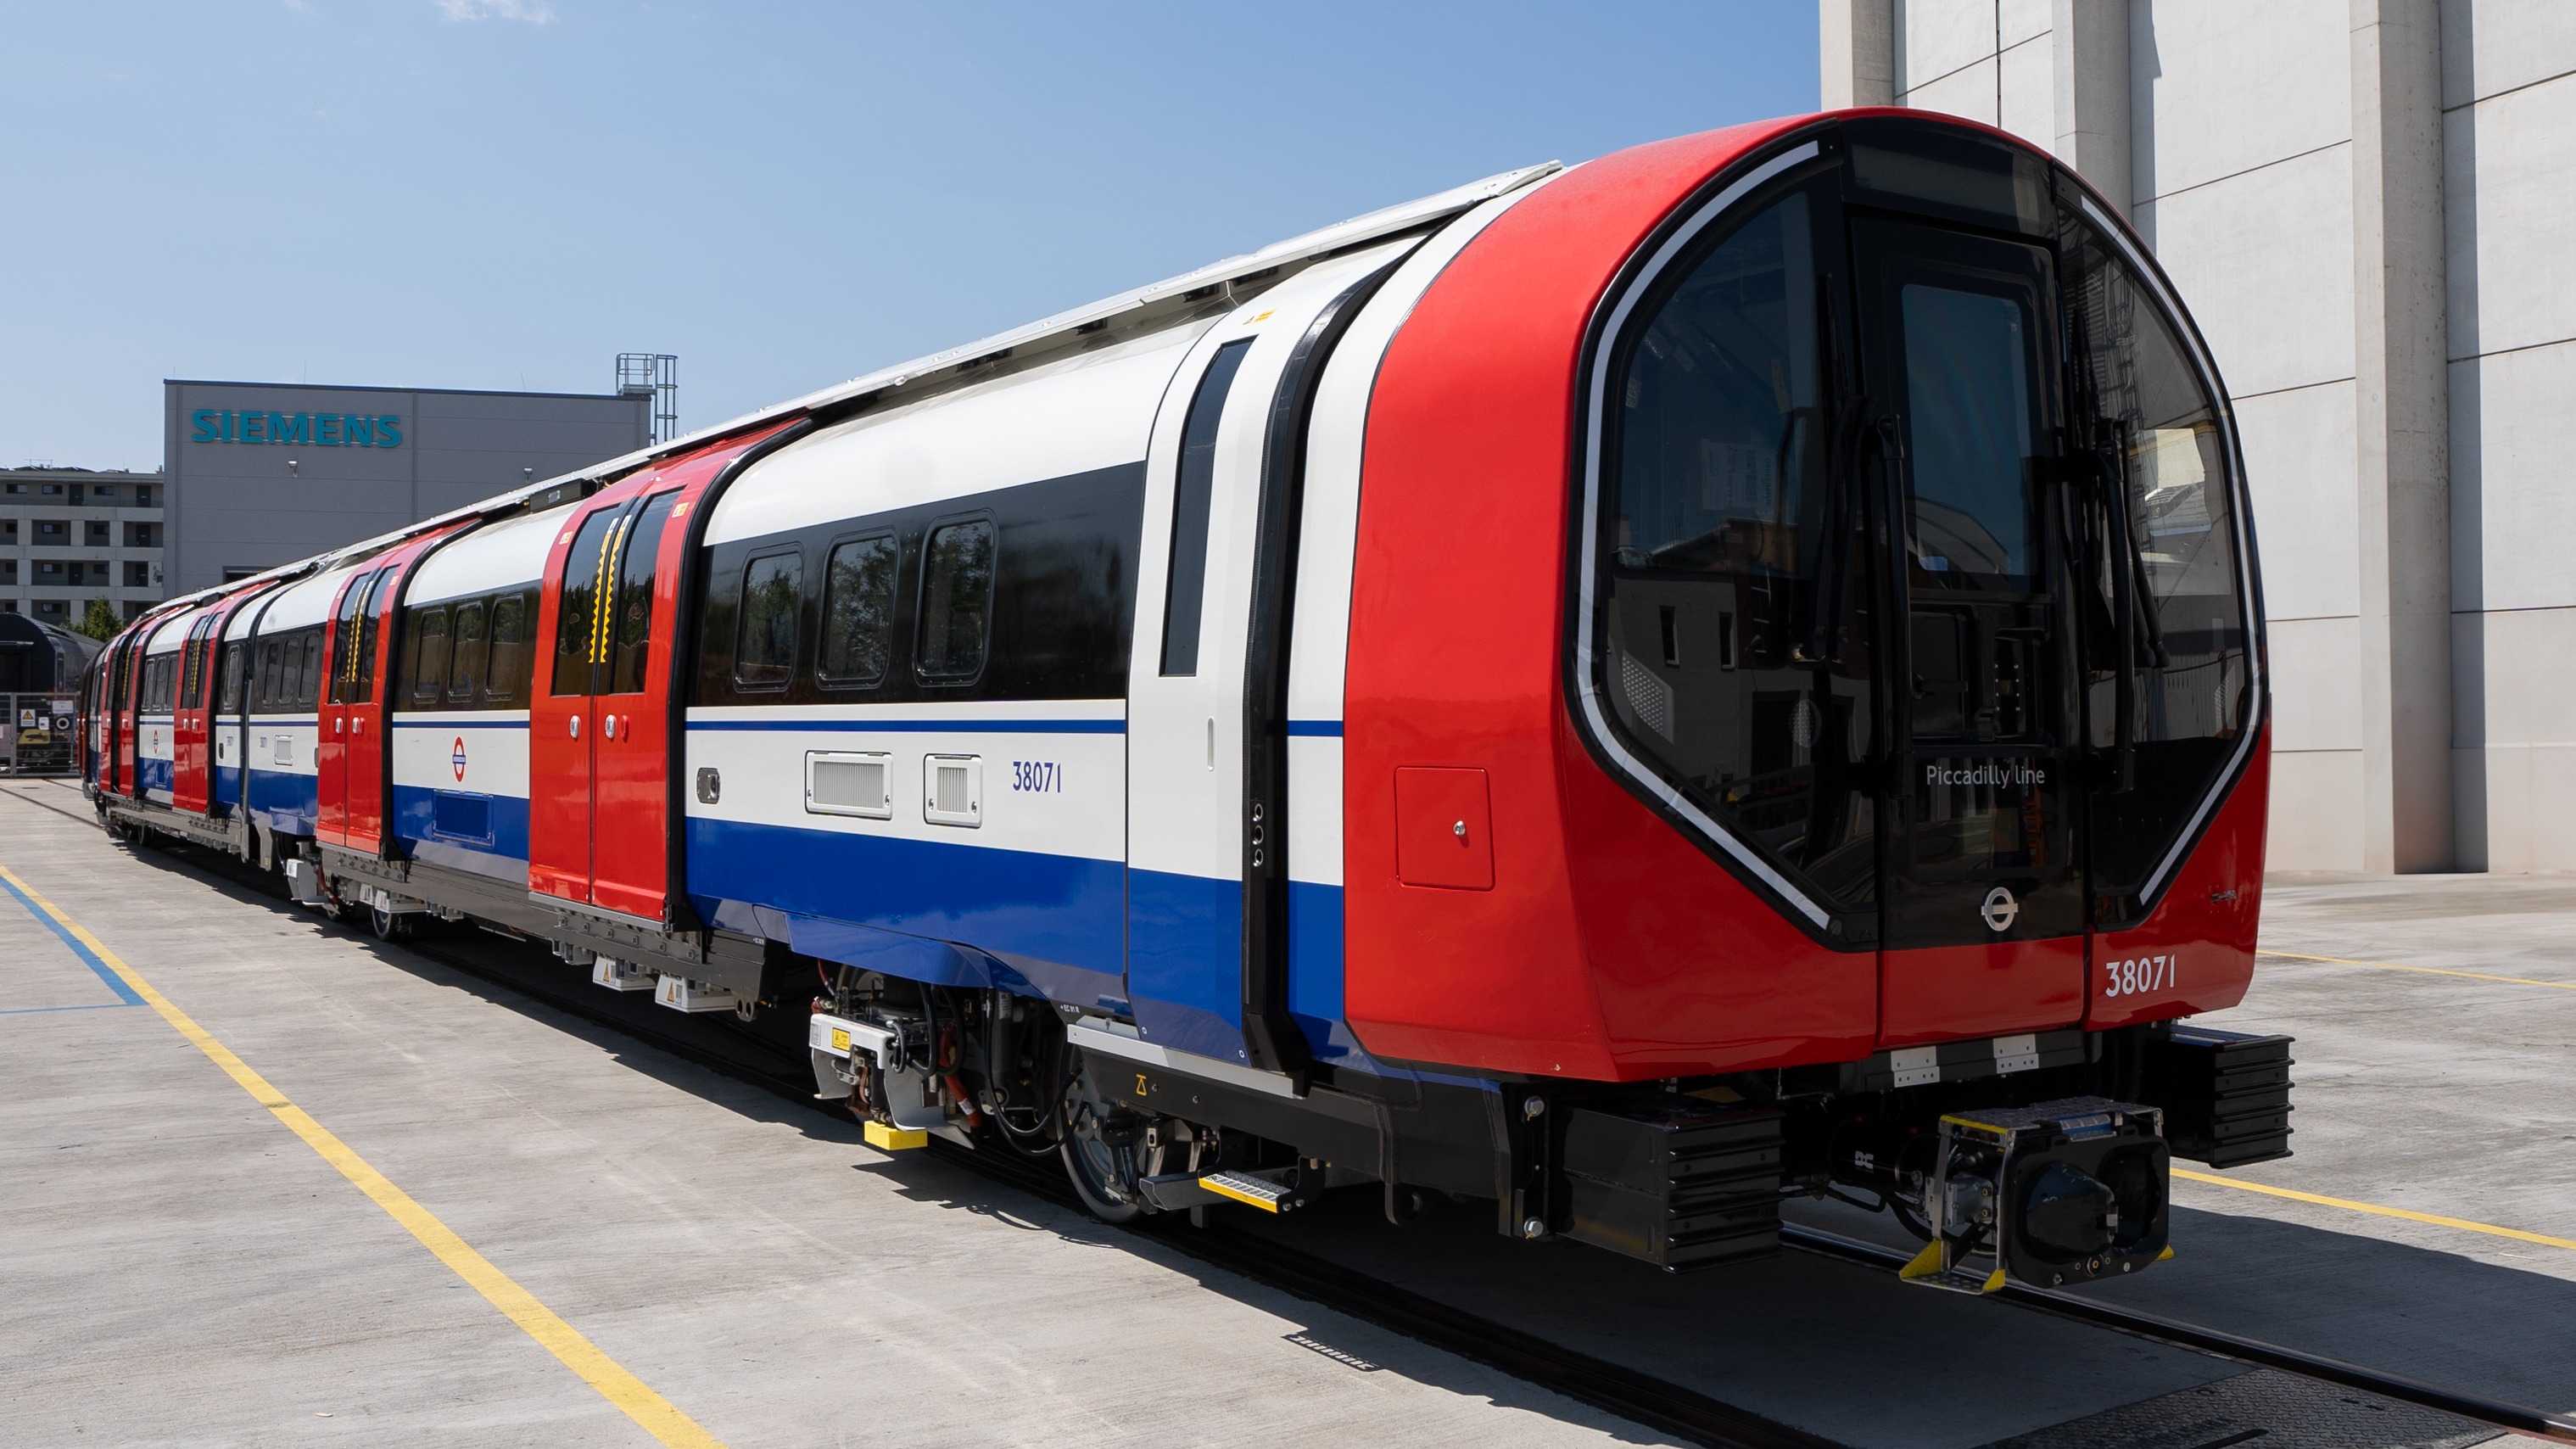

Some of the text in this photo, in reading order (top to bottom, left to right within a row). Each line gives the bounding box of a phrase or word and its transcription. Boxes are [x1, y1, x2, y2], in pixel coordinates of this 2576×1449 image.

[191, 409, 402, 448] SIEMENS
[1012, 761, 1061, 793] 38071
[1926, 764, 2045, 789] Piccadilly line
[2105, 954, 2176, 998] 38071
